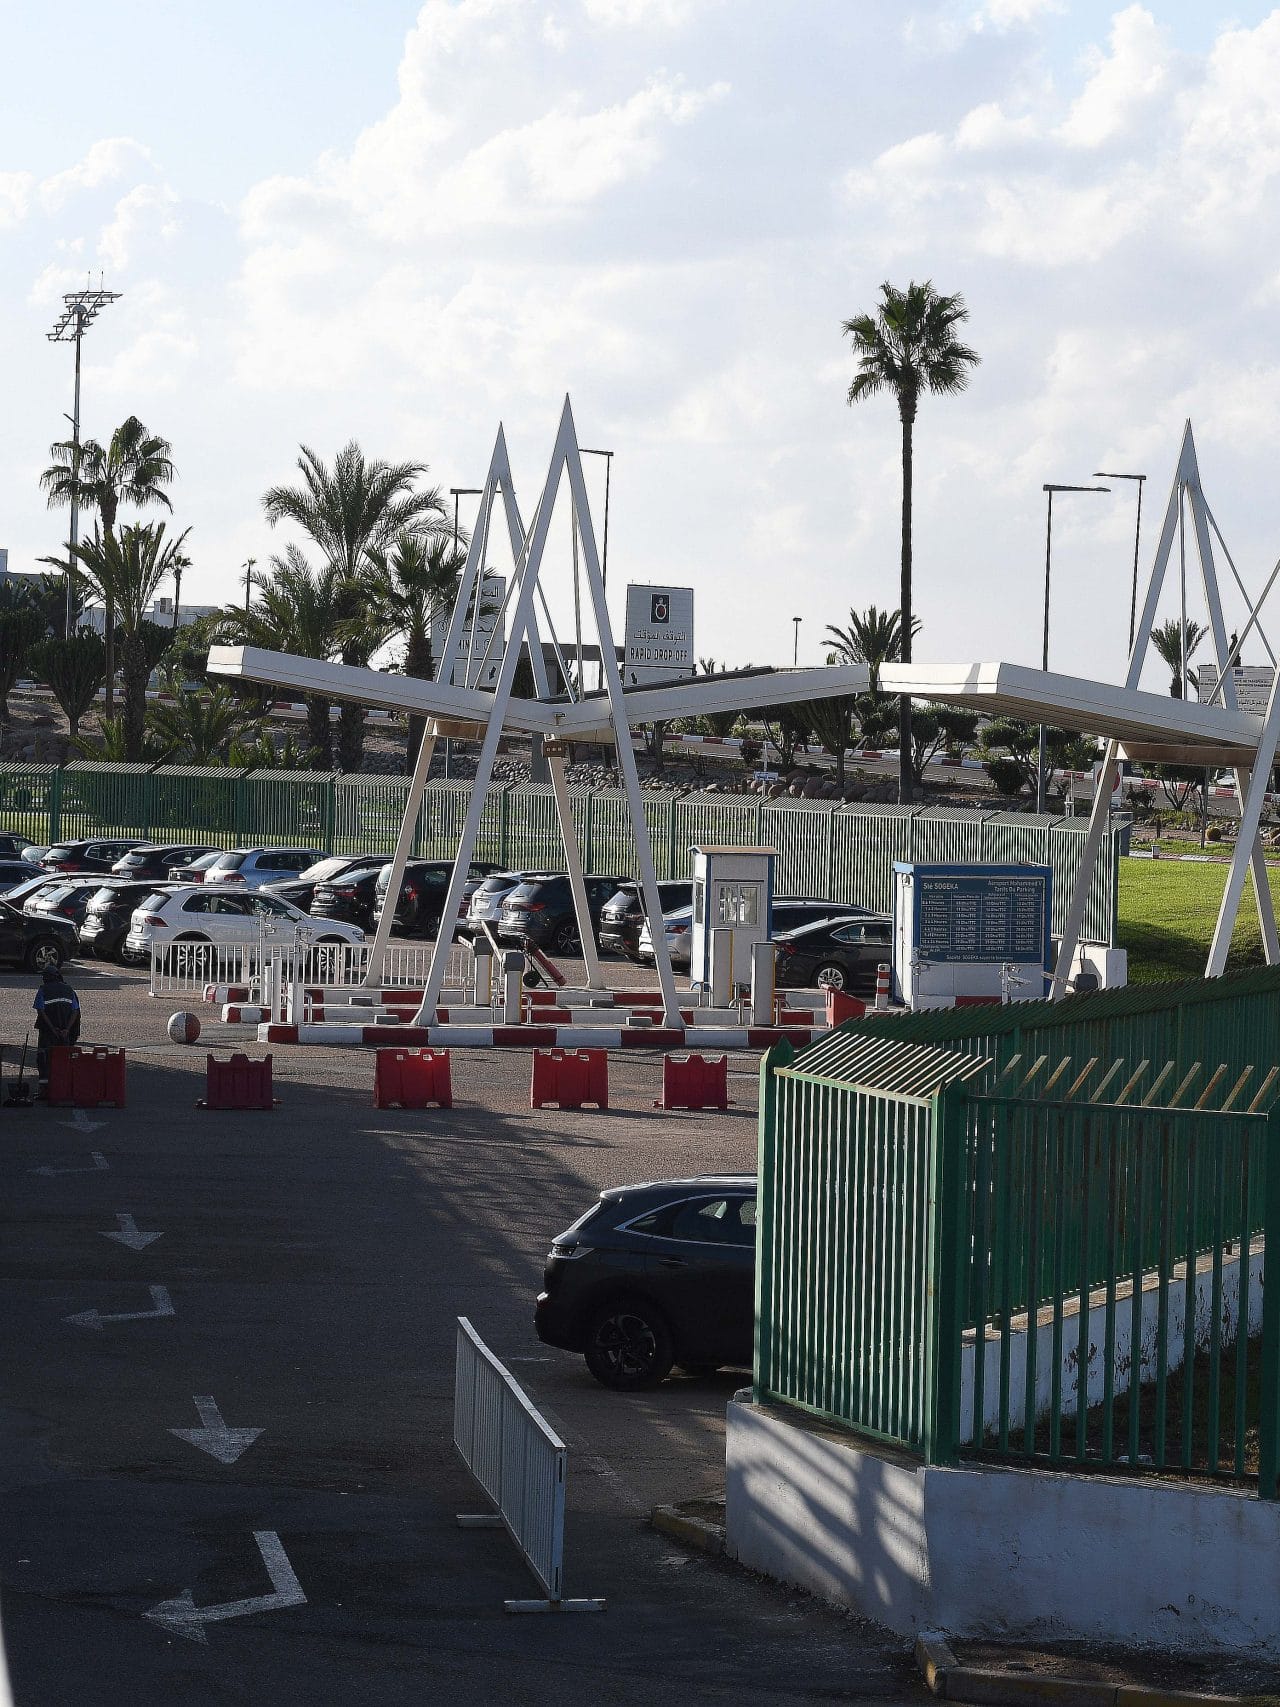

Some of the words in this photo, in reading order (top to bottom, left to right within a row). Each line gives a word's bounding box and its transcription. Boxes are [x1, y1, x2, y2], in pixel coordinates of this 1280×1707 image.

[630, 647, 652, 660] RAPID
[654, 649, 688, 661] DROP-OFF
[934, 882, 959, 890] SOGEKA
[1016, 886, 1036, 894] Parking
